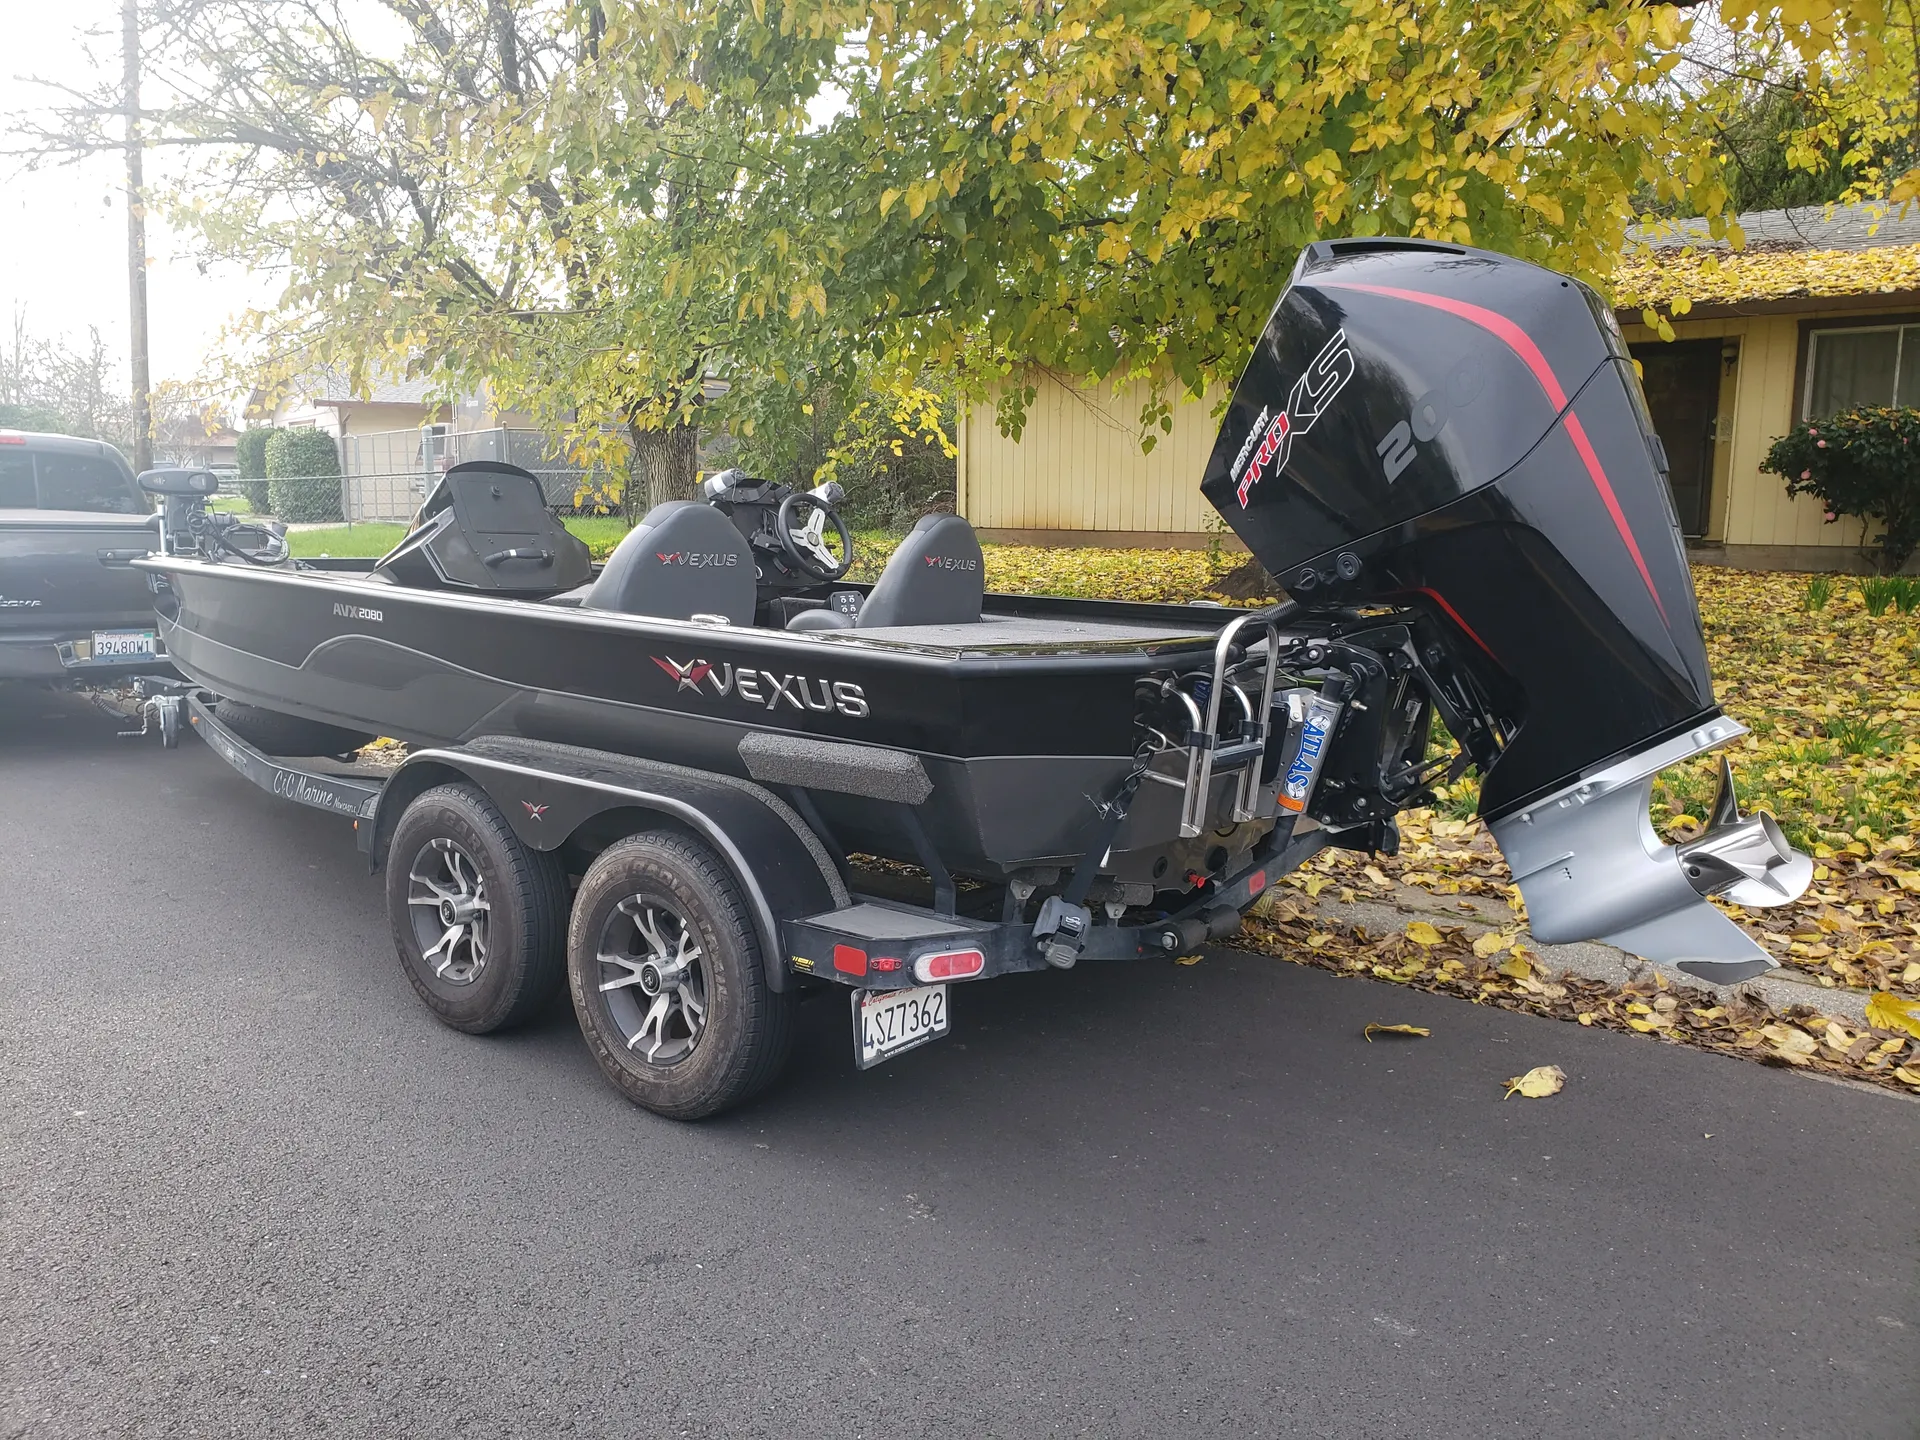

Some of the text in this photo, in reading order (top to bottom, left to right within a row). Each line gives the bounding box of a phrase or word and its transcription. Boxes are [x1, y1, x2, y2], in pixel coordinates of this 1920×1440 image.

[1230, 404, 1269, 483] MERCURY
[1237, 411, 1290, 509] PRO
[677, 551, 738, 569] VEXUS
[937, 556, 977, 571] VEXUS
[97, 640, 149, 655] 39480W1
[697, 658, 871, 718] VEXUS
[1286, 718, 1327, 789] ATLAS
[295, 775, 333, 806] Marine
[632, 860, 700, 918] RADIAL
[863, 991, 944, 1049] 4SZ7362
